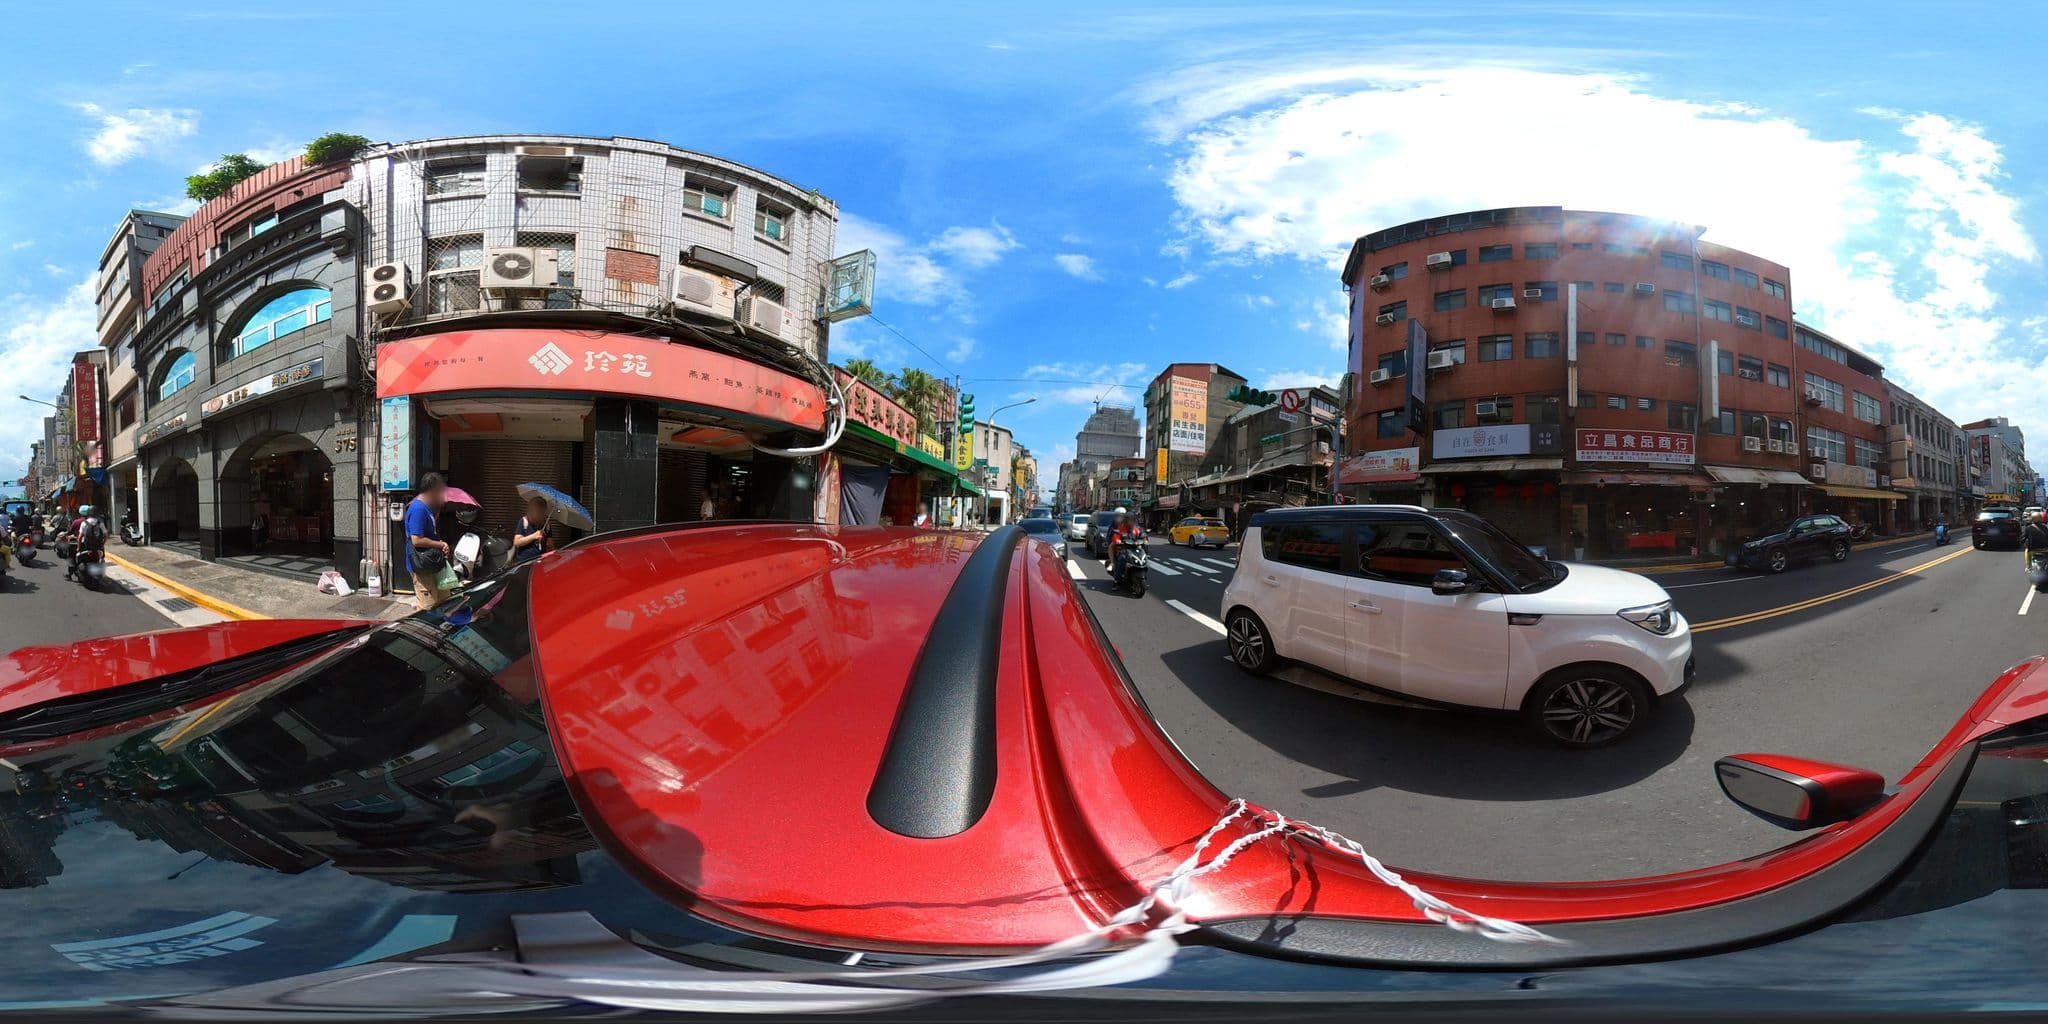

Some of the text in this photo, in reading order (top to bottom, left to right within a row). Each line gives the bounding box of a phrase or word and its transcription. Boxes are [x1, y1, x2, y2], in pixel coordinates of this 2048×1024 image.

[583, 351, 652, 378] 珍苑
[1173, 420, 1205, 432] 民生西路
[1173, 430, 1205, 441] 店面/住宅
[1585, 433, 1689, 450] 立昌食品商行
[335, 437, 357, 453] 375
